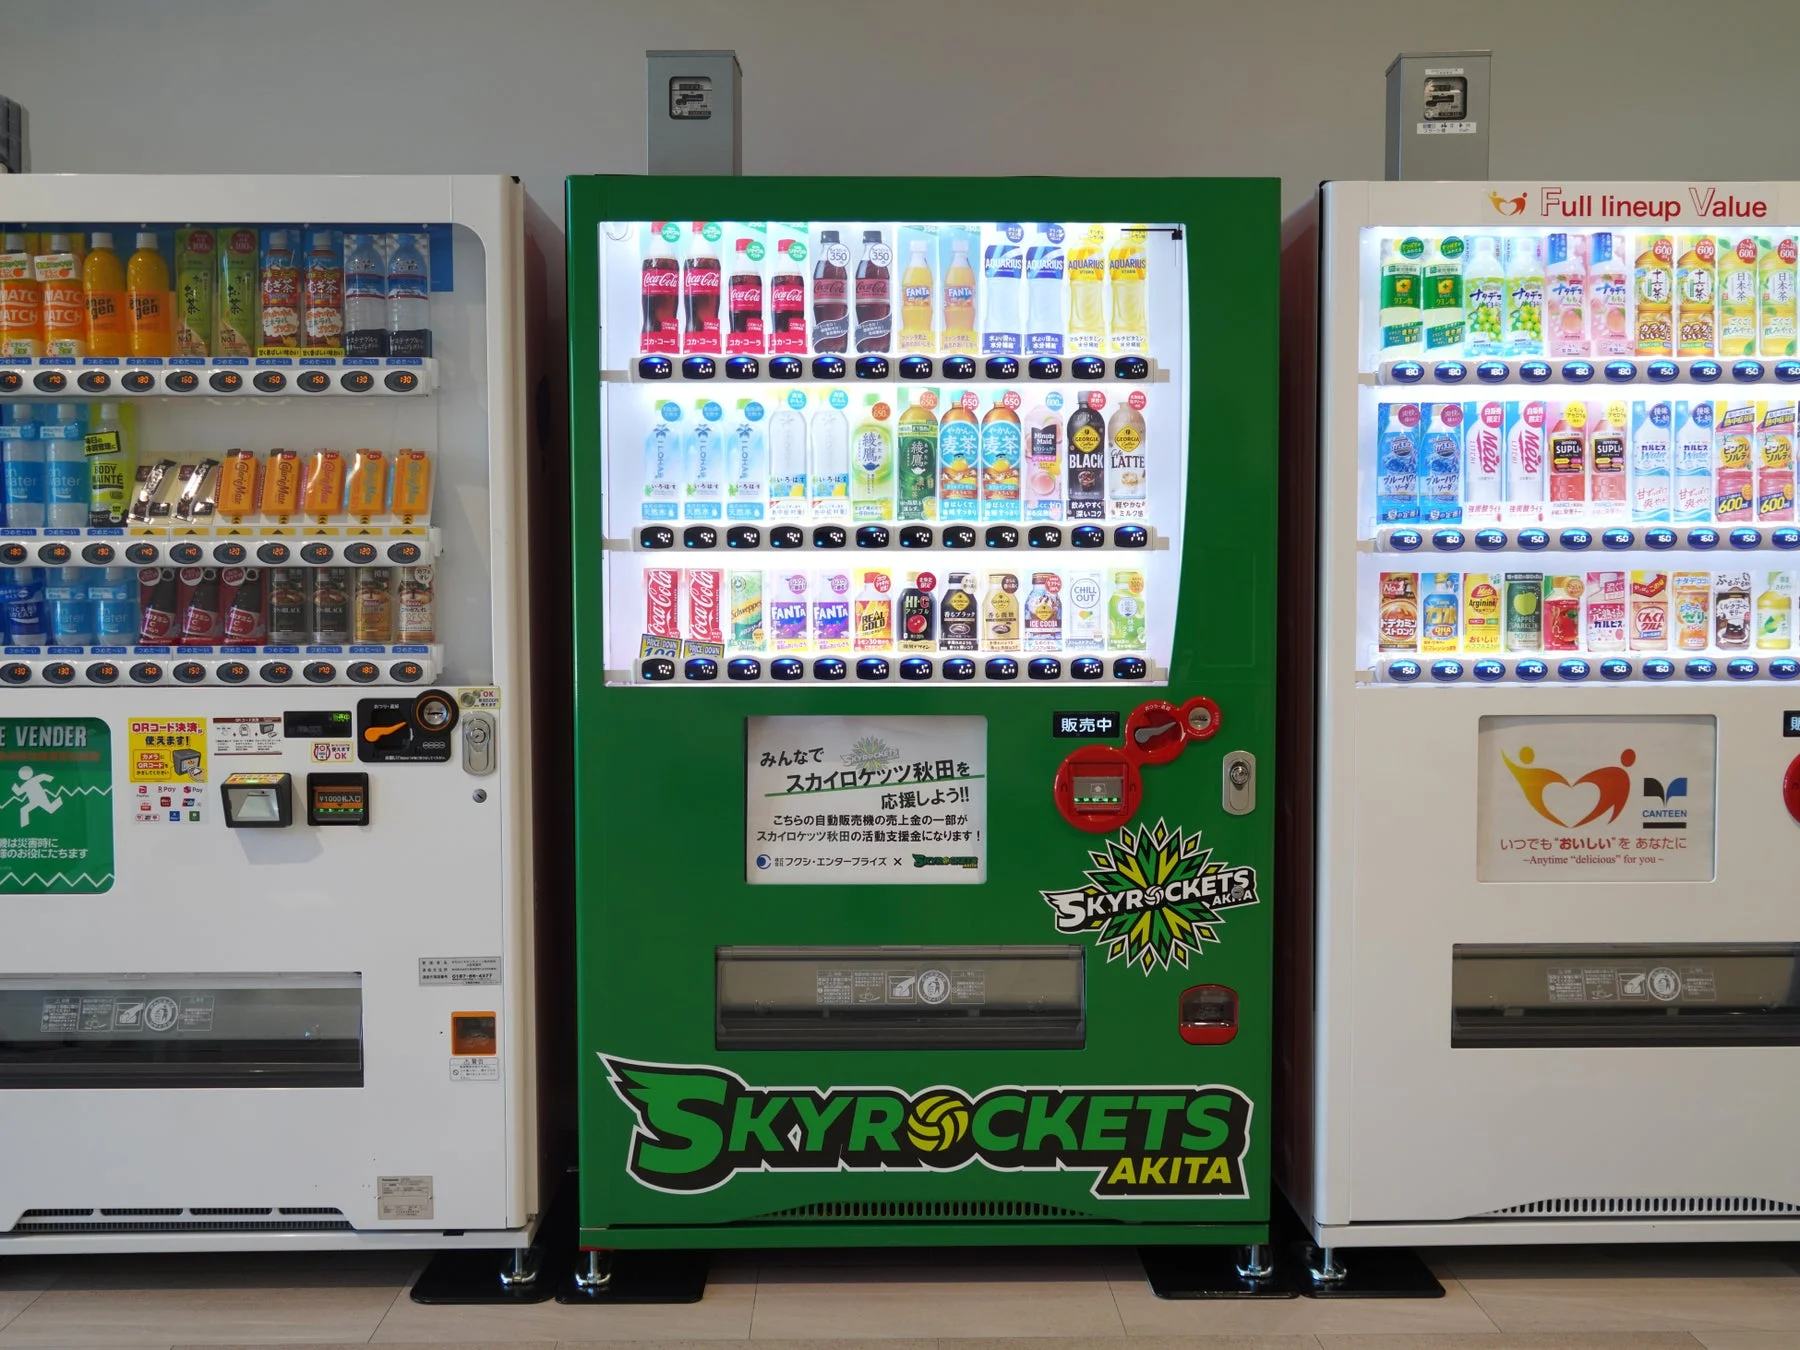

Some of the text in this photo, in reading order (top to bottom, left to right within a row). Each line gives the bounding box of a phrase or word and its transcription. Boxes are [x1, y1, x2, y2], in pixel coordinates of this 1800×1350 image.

[1541, 187, 1768, 222] Full lineup Value
[1655, 246, 1672, 255] 600
[1697, 246, 1714, 255] 600
[985, 258, 1022, 271] AQUARIUS
[1026, 259, 1064, 271] AQUARIUS
[1068, 259, 1104, 270] AQUARIUS
[1110, 259, 1146, 270] AQUARIUS
[265, 278, 294, 293] むぎ茶
[643, 272, 679, 287] Coca-Cola
[685, 272, 719, 287] Coca-Cola
[1652, 270, 1664, 301] 十六茶
[1694, 270, 1706, 301] 十六茶
[308, 279, 338, 294] むぎ茶
[814, 281, 844, 293] Coca-Cola
[856, 281, 886, 293] Coca-Cola
[906, 287, 930, 297] FANTA
[948, 288, 972, 297] FANTA
[1736, 272, 1746, 301] 日本茶
[1778, 272, 1787, 301] 日本茶
[731, 289, 760, 302] Coca-Cola
[772, 289, 802, 302] Coca-Cola
[1640, 323, 1672, 333] カラダに
[1682, 323, 1712, 333] カラダに
[1640, 332, 1671, 341] いいこと
[1682, 332, 1712, 341] いいこと
[1487, 415, 1500, 423] 限定!
[1529, 415, 1542, 423] 限定!
[863, 432, 877, 462] 綾鷹
[942, 436, 977, 455] 麦茶
[982, 434, 1019, 455] 麦茶
[911, 441, 924, 467] 綾鷹
[1480, 430, 1500, 474] Mets
[1522, 430, 1542, 474] Mets
[1641, 451, 1666, 461] Water
[1684, 451, 1708, 461] Water
[1069, 454, 1104, 468] BLACK
[1111, 456, 1145, 468] LATTE
[648, 570, 672, 638] Coca-Cola
[690, 570, 713, 640] Coca-Cola
[771, 605, 806, 619] FANTA
[814, 604, 849, 619] FANTA
[862, 610, 885, 623] REAL
[862, 619, 885, 632] GOLD
[1380, 619, 1416, 628] ドデカミン
[1385, 628, 1414, 636] ストロング
[646, 638, 678, 648] PRICE DOWN
[689, 644, 703, 653] PRICE
[1061, 718, 1112, 732] 販売中
[16, 725, 87, 747] VENDER
[760, 748, 824, 768] みんなで
[840, 747, 900, 766] SKYROCKETS
[786, 760, 971, 793] スカイロケッツ秋田を
[1642, 810, 1687, 818] CANTEEN
[773, 815, 968, 827] こちらの自動販売機の売上金の一部が
[756, 830, 980, 842] スカイロケッツ秋田の活動支援金になります!
[1635, 837, 1687, 850] あなたに
[912, 853, 978, 868] SKYROCKETS
[1623, 855, 1636, 864] for
[1639, 857, 1656, 866] you
[1044, 870, 1250, 928] SKYROCKETS
[1212, 890, 1253, 906] AKA
[621, 1068, 1232, 1174] SKYROCKETS
[1107, 1156, 1231, 1184] AKITA
